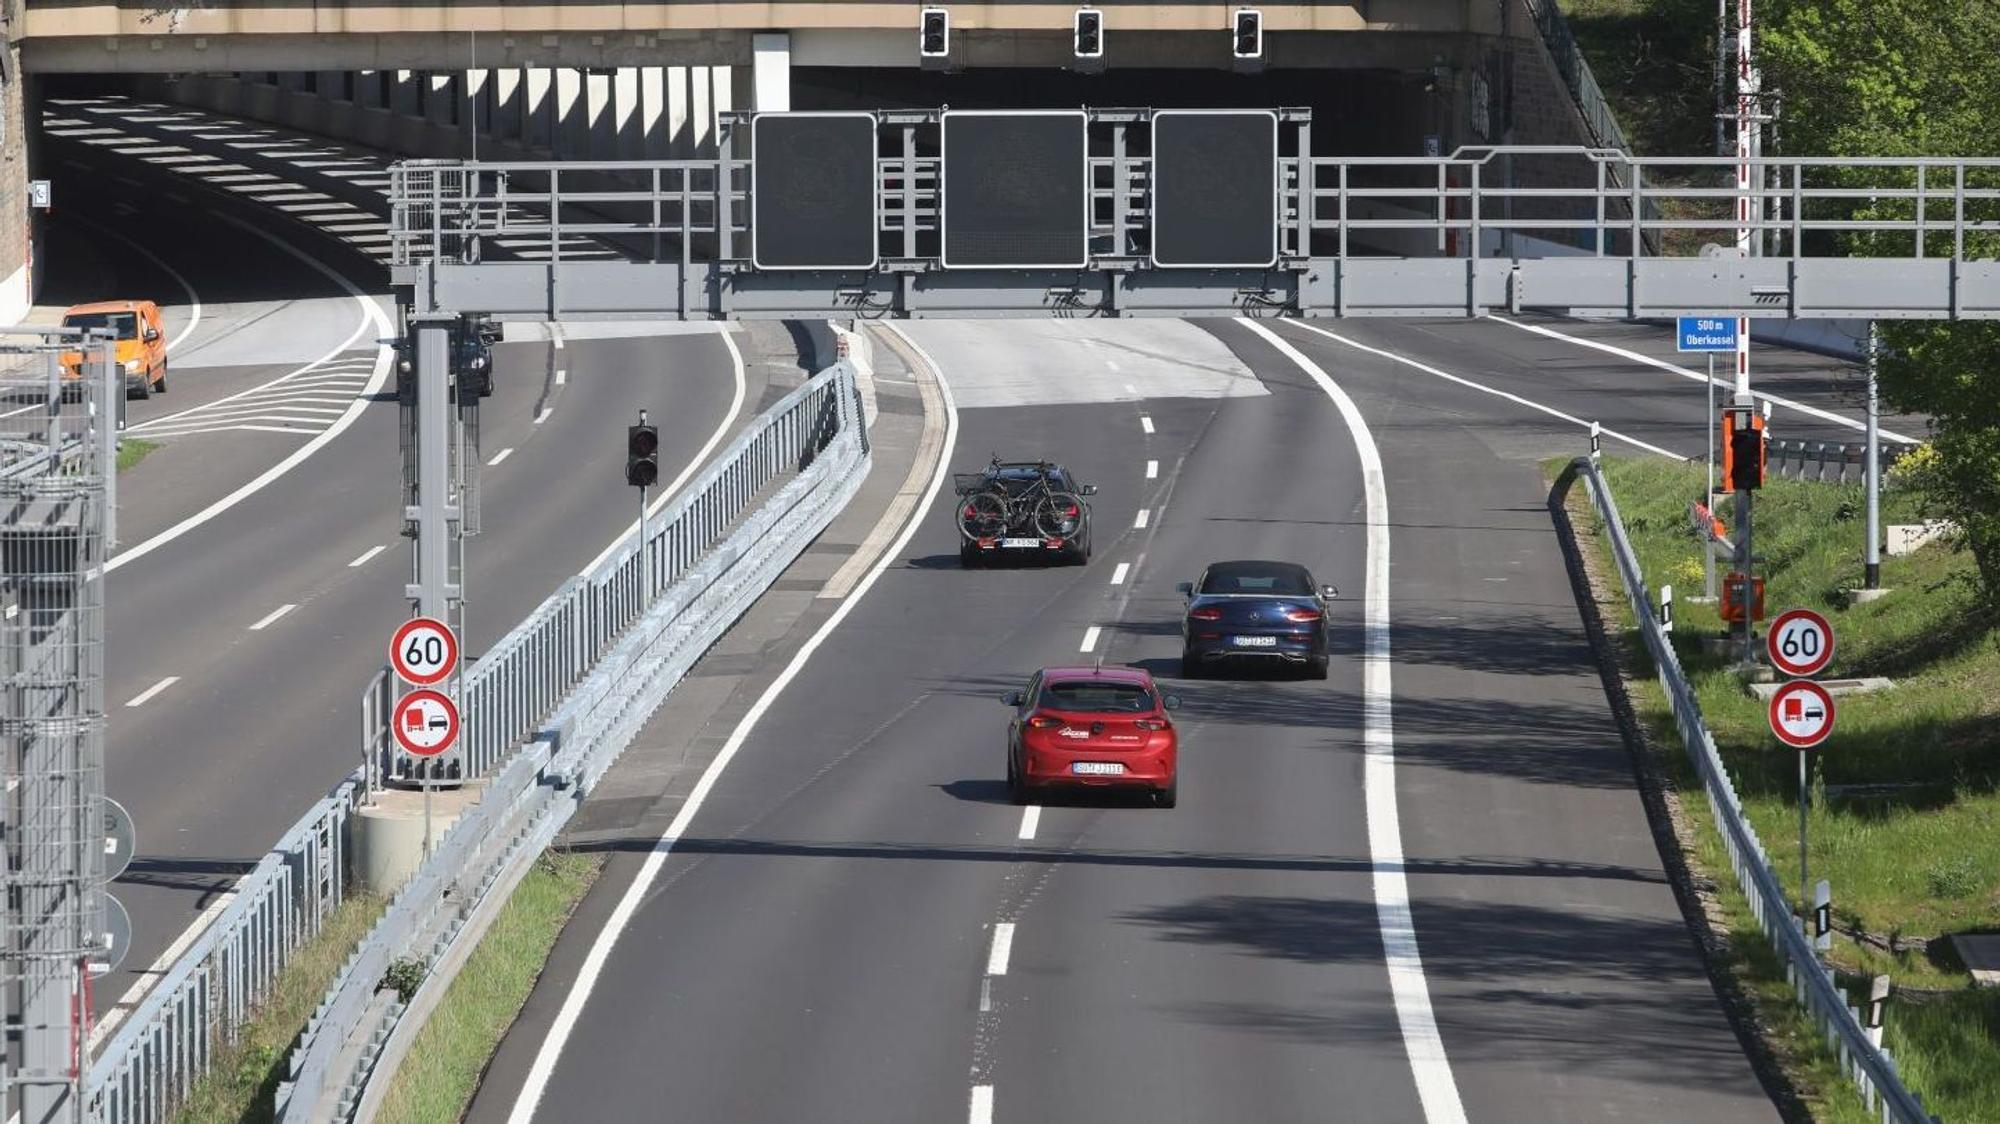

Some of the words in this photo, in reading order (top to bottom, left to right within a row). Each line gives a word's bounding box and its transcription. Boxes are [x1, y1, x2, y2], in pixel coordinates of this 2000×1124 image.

[1697, 320, 1714, 331] 500
[1715, 322, 1724, 330] m
[1686, 334, 1735, 345] Oberkassel
[406, 636, 442, 666] 60
[1782, 628, 1818, 657] 60
